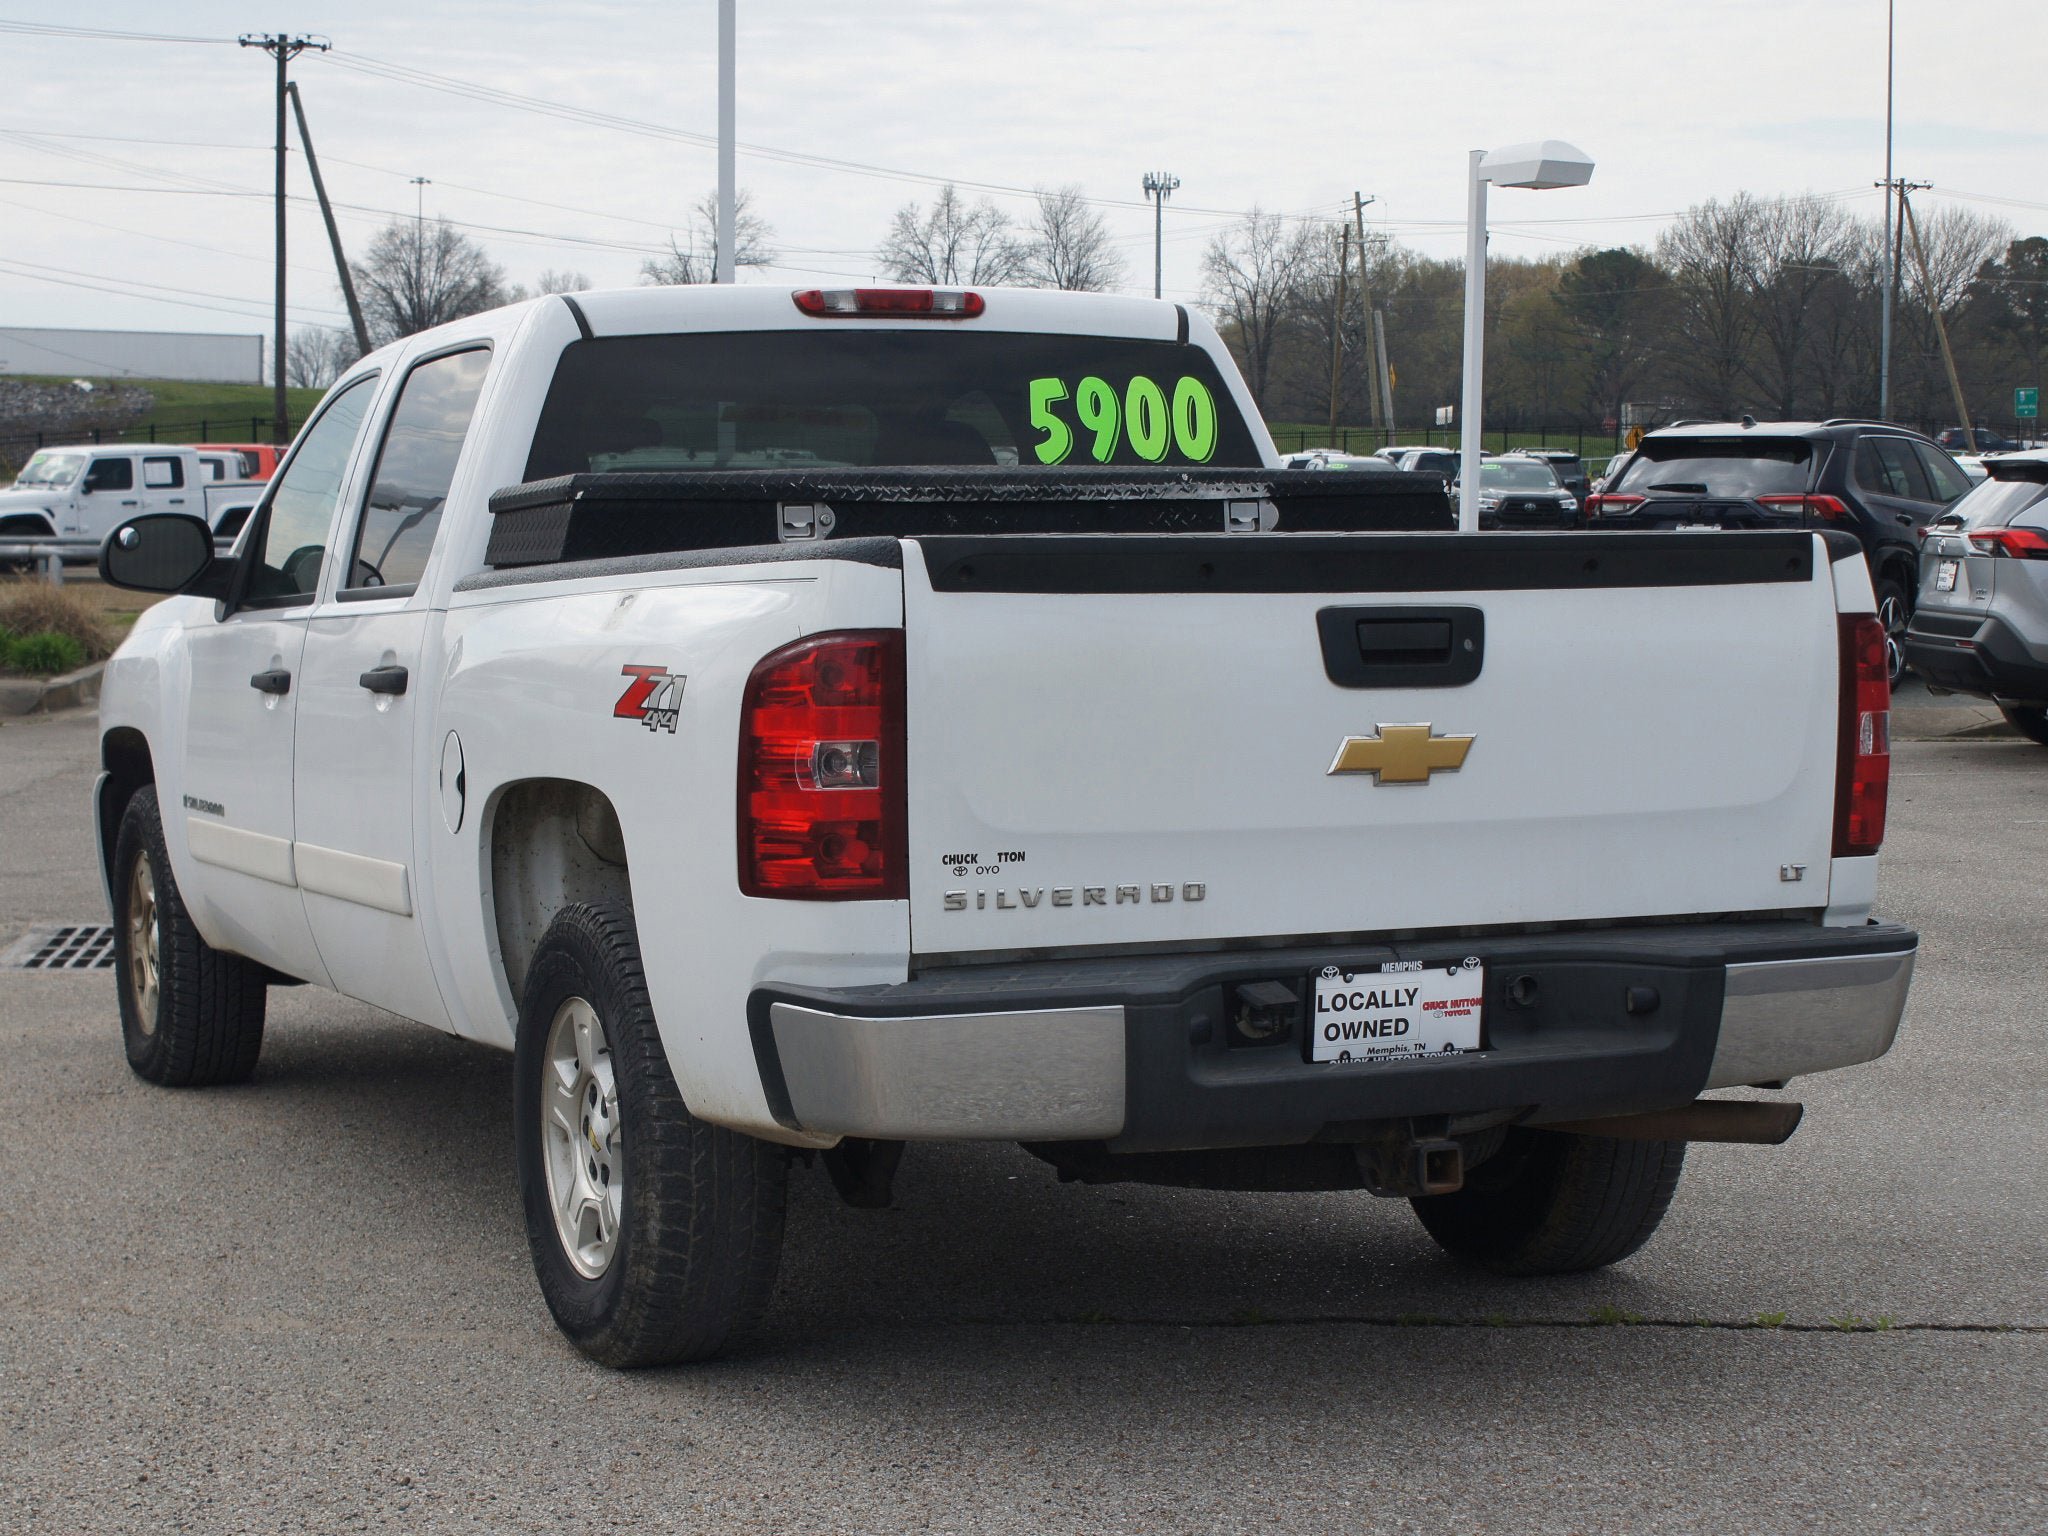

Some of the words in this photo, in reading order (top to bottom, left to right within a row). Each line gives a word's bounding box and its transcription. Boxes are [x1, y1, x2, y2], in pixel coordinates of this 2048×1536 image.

[1029, 375, 1218, 465] 5900
[613, 664, 687, 720] Z71
[942, 852, 978, 865] CHUCK
[1780, 864, 1807, 882] LT
[943, 881, 1206, 911] SILVERADO
[1381, 960, 1423, 973] MEMPHIS
[1317, 987, 1419, 1013] LOCALLY
[1422, 1000, 1449, 1011] CHUCK
[1450, 997, 1484, 1009] HUTTON
[1444, 1008, 1472, 1017] TOYOTA
[1324, 1017, 1410, 1042] OWNED
[1366, 1043, 1410, 1056] Memphis,
[1414, 1043, 1426, 1051] TN
